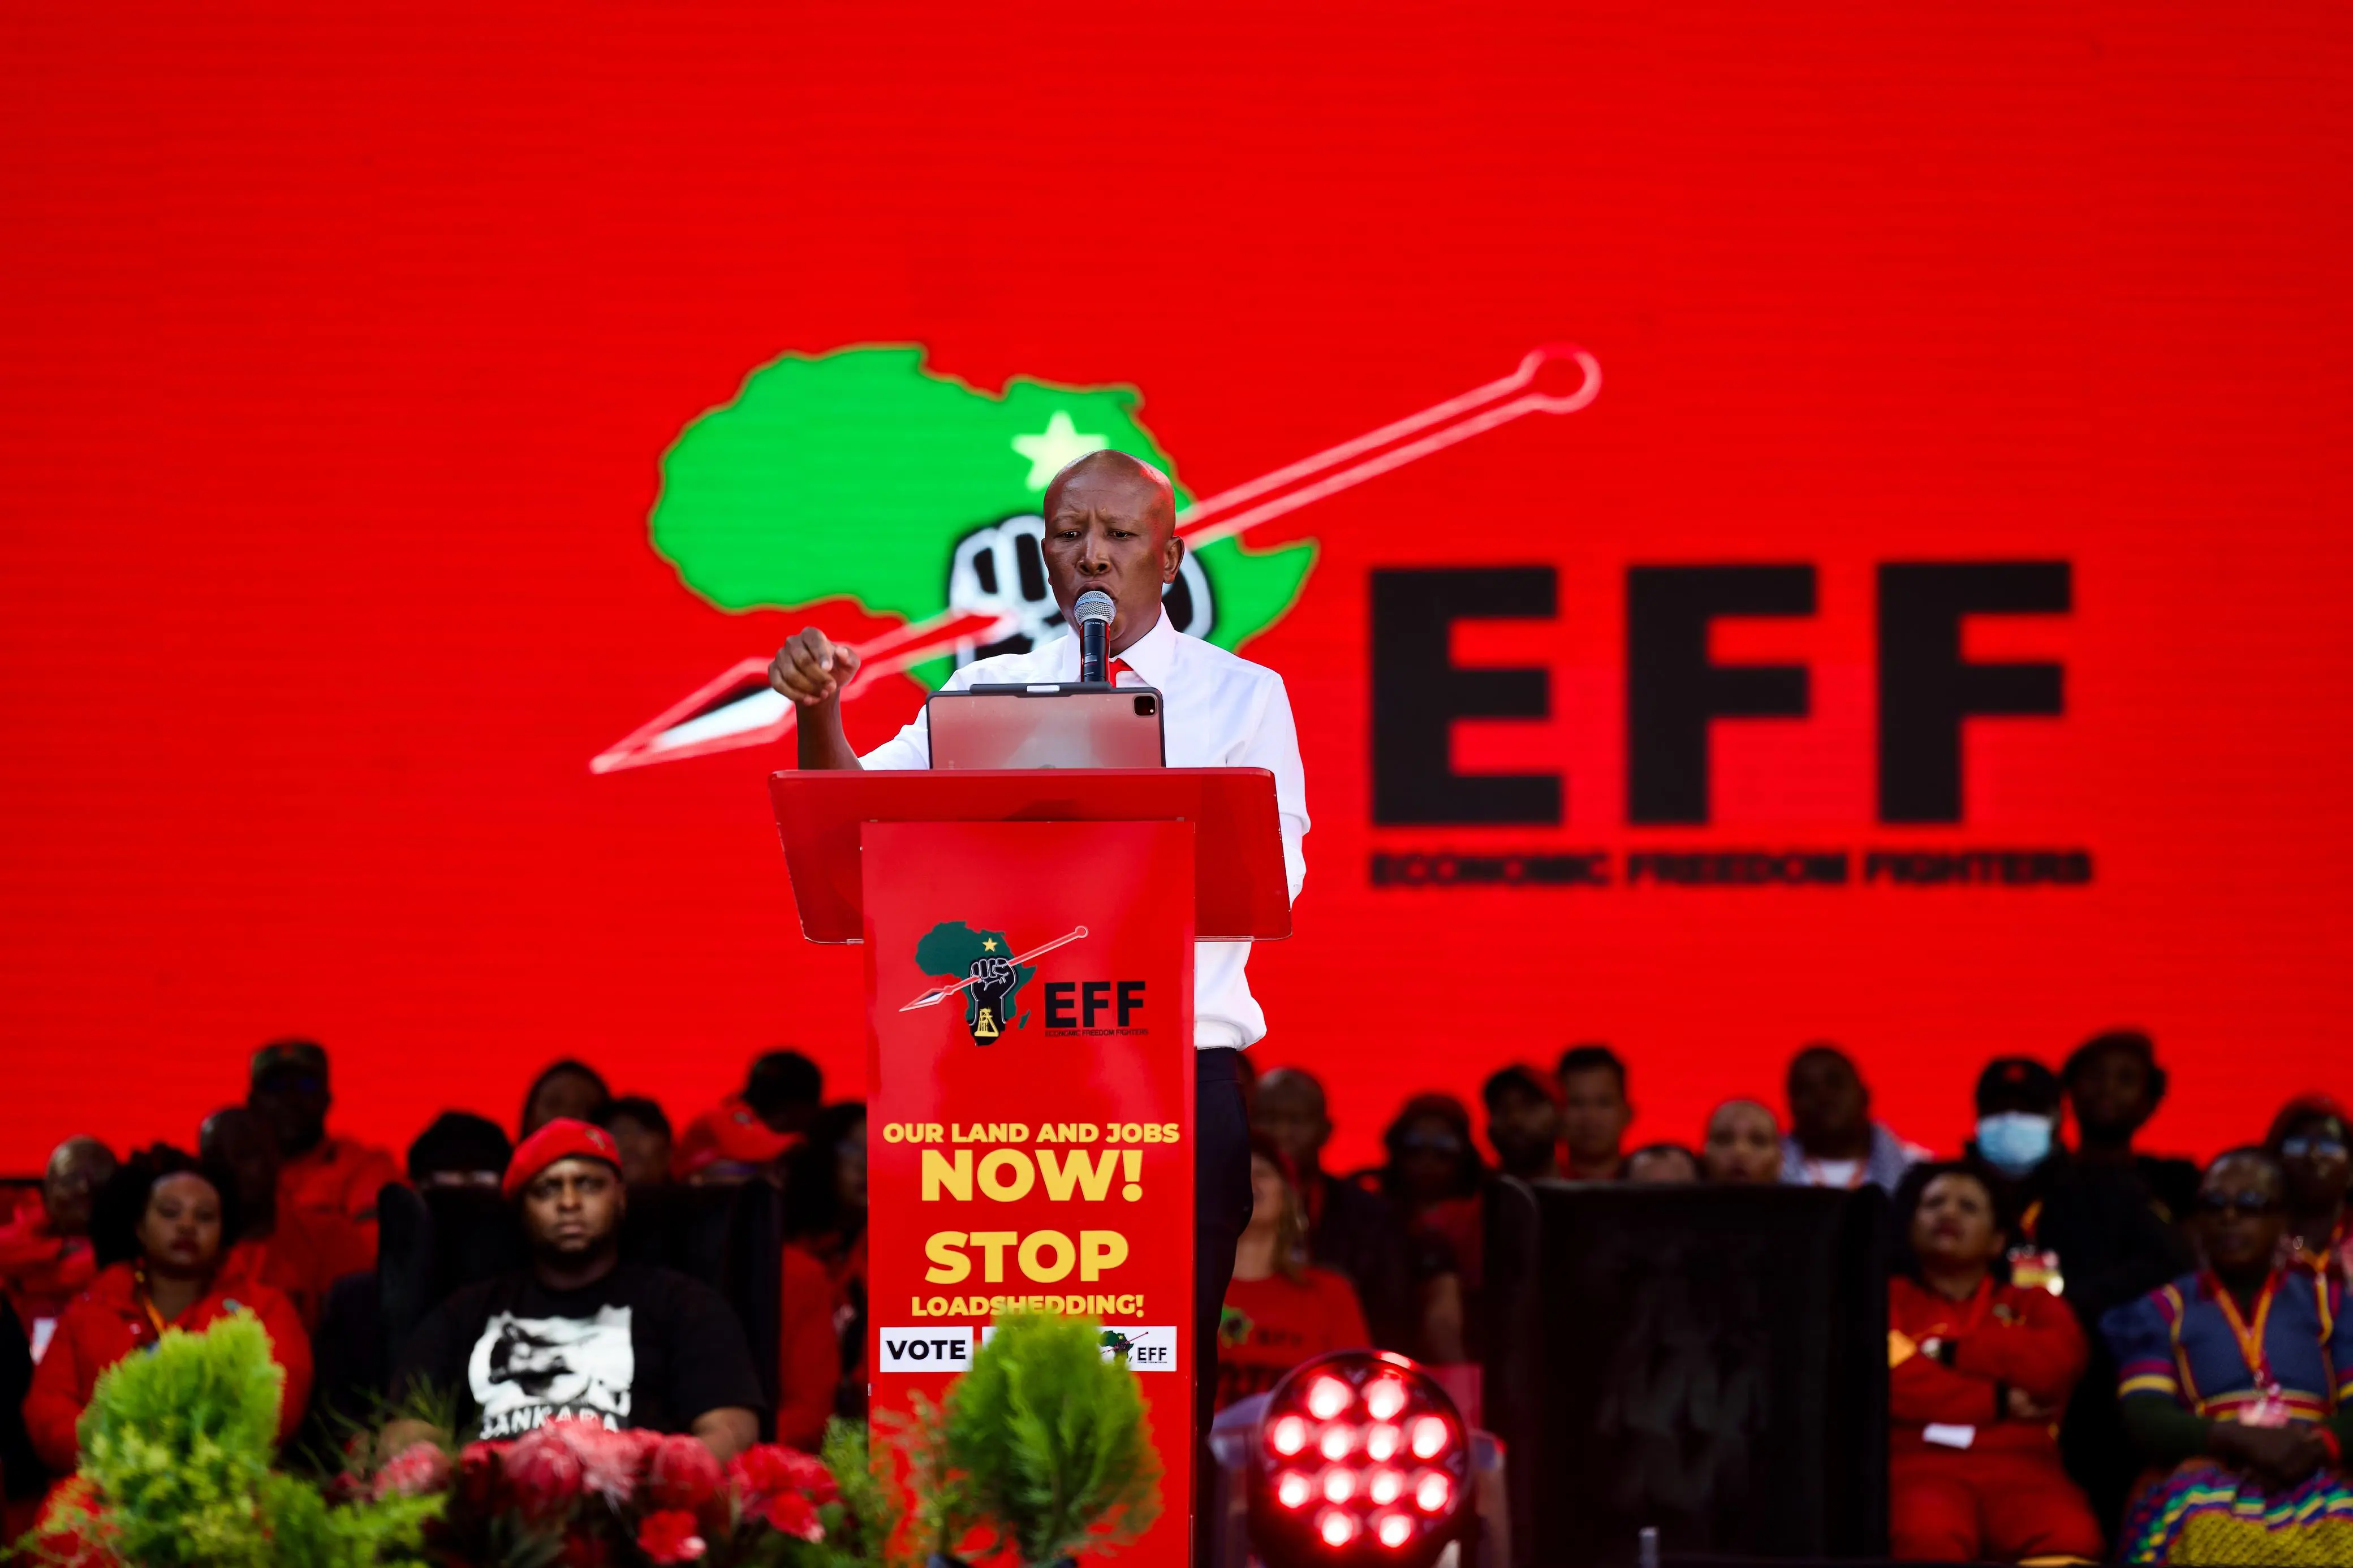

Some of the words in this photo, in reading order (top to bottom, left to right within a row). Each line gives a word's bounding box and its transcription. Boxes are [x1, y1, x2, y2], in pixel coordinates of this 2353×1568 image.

[1368, 559, 2074, 828] EFF
[1044, 981, 1146, 1028] EFF
[883, 1123, 943, 1143] OUR
[951, 1123, 1029, 1143] LAND
[1036, 1123, 1099, 1143] AND
[1105, 1123, 1180, 1143] JOBS
[921, 1148, 1143, 1202] NOW!
[925, 1230, 1129, 1284] STOP
[911, 1294, 1144, 1318] LOADSHEDDING!
[886, 1340, 966, 1360] VOTE
[1137, 1347, 1167, 1360] EFF
